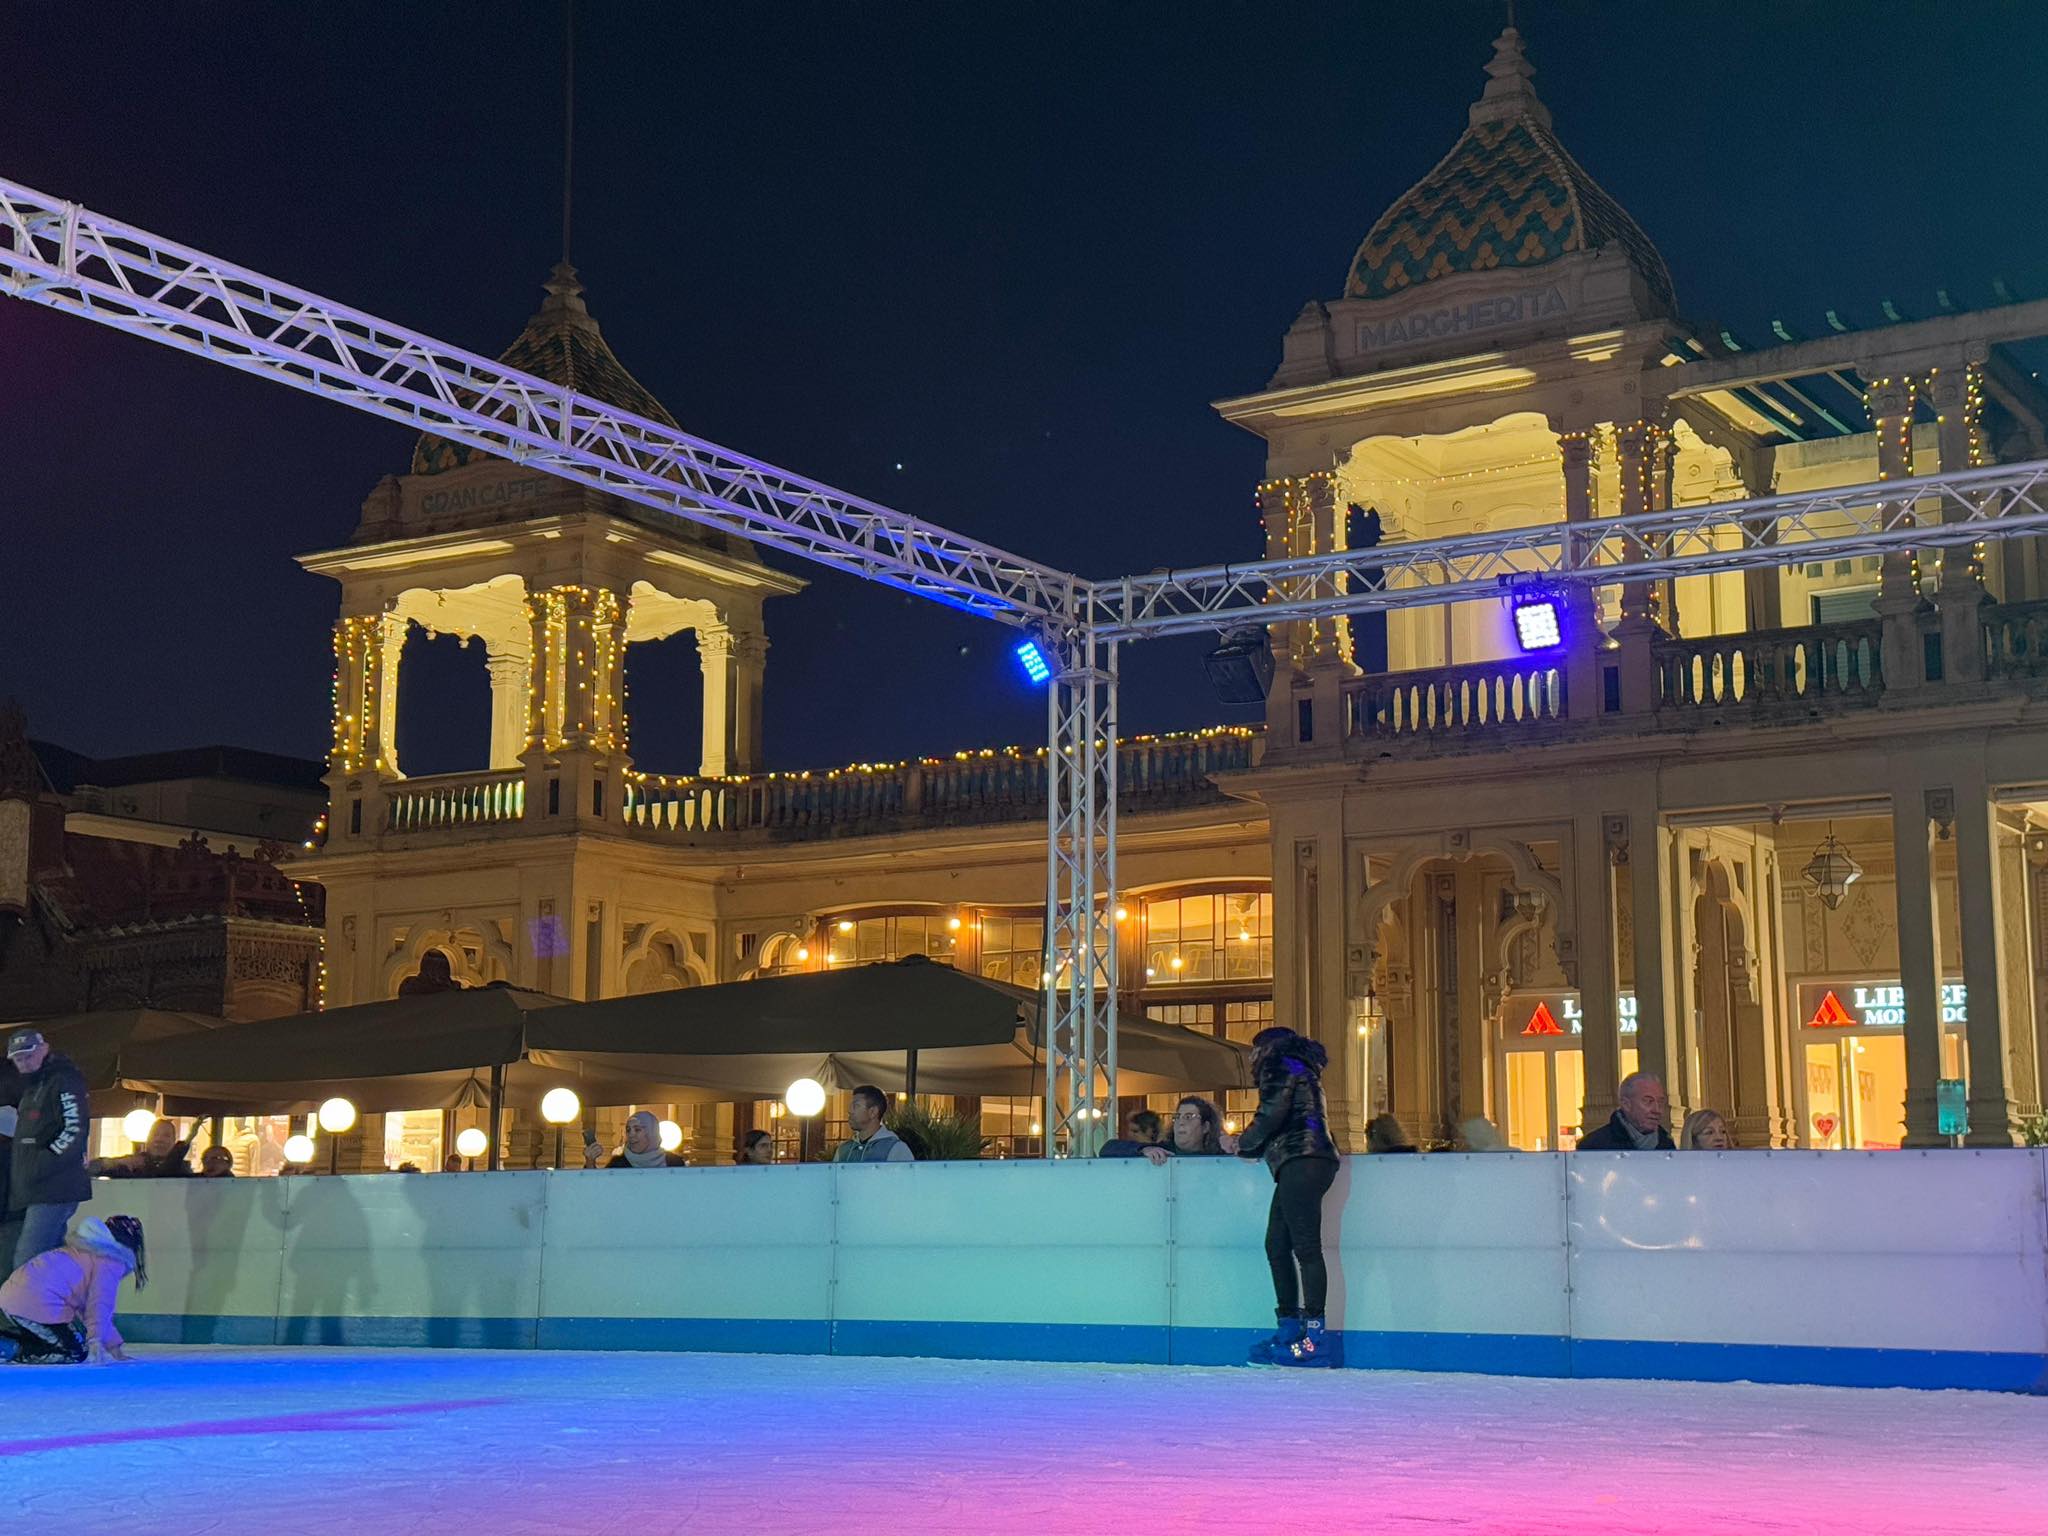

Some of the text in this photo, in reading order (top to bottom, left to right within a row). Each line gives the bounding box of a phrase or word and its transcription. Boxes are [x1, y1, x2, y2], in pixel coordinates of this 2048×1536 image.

[1360, 287, 1567, 351] MARGHERITA
[50, 1092, 80, 1154] ICE STAFF
